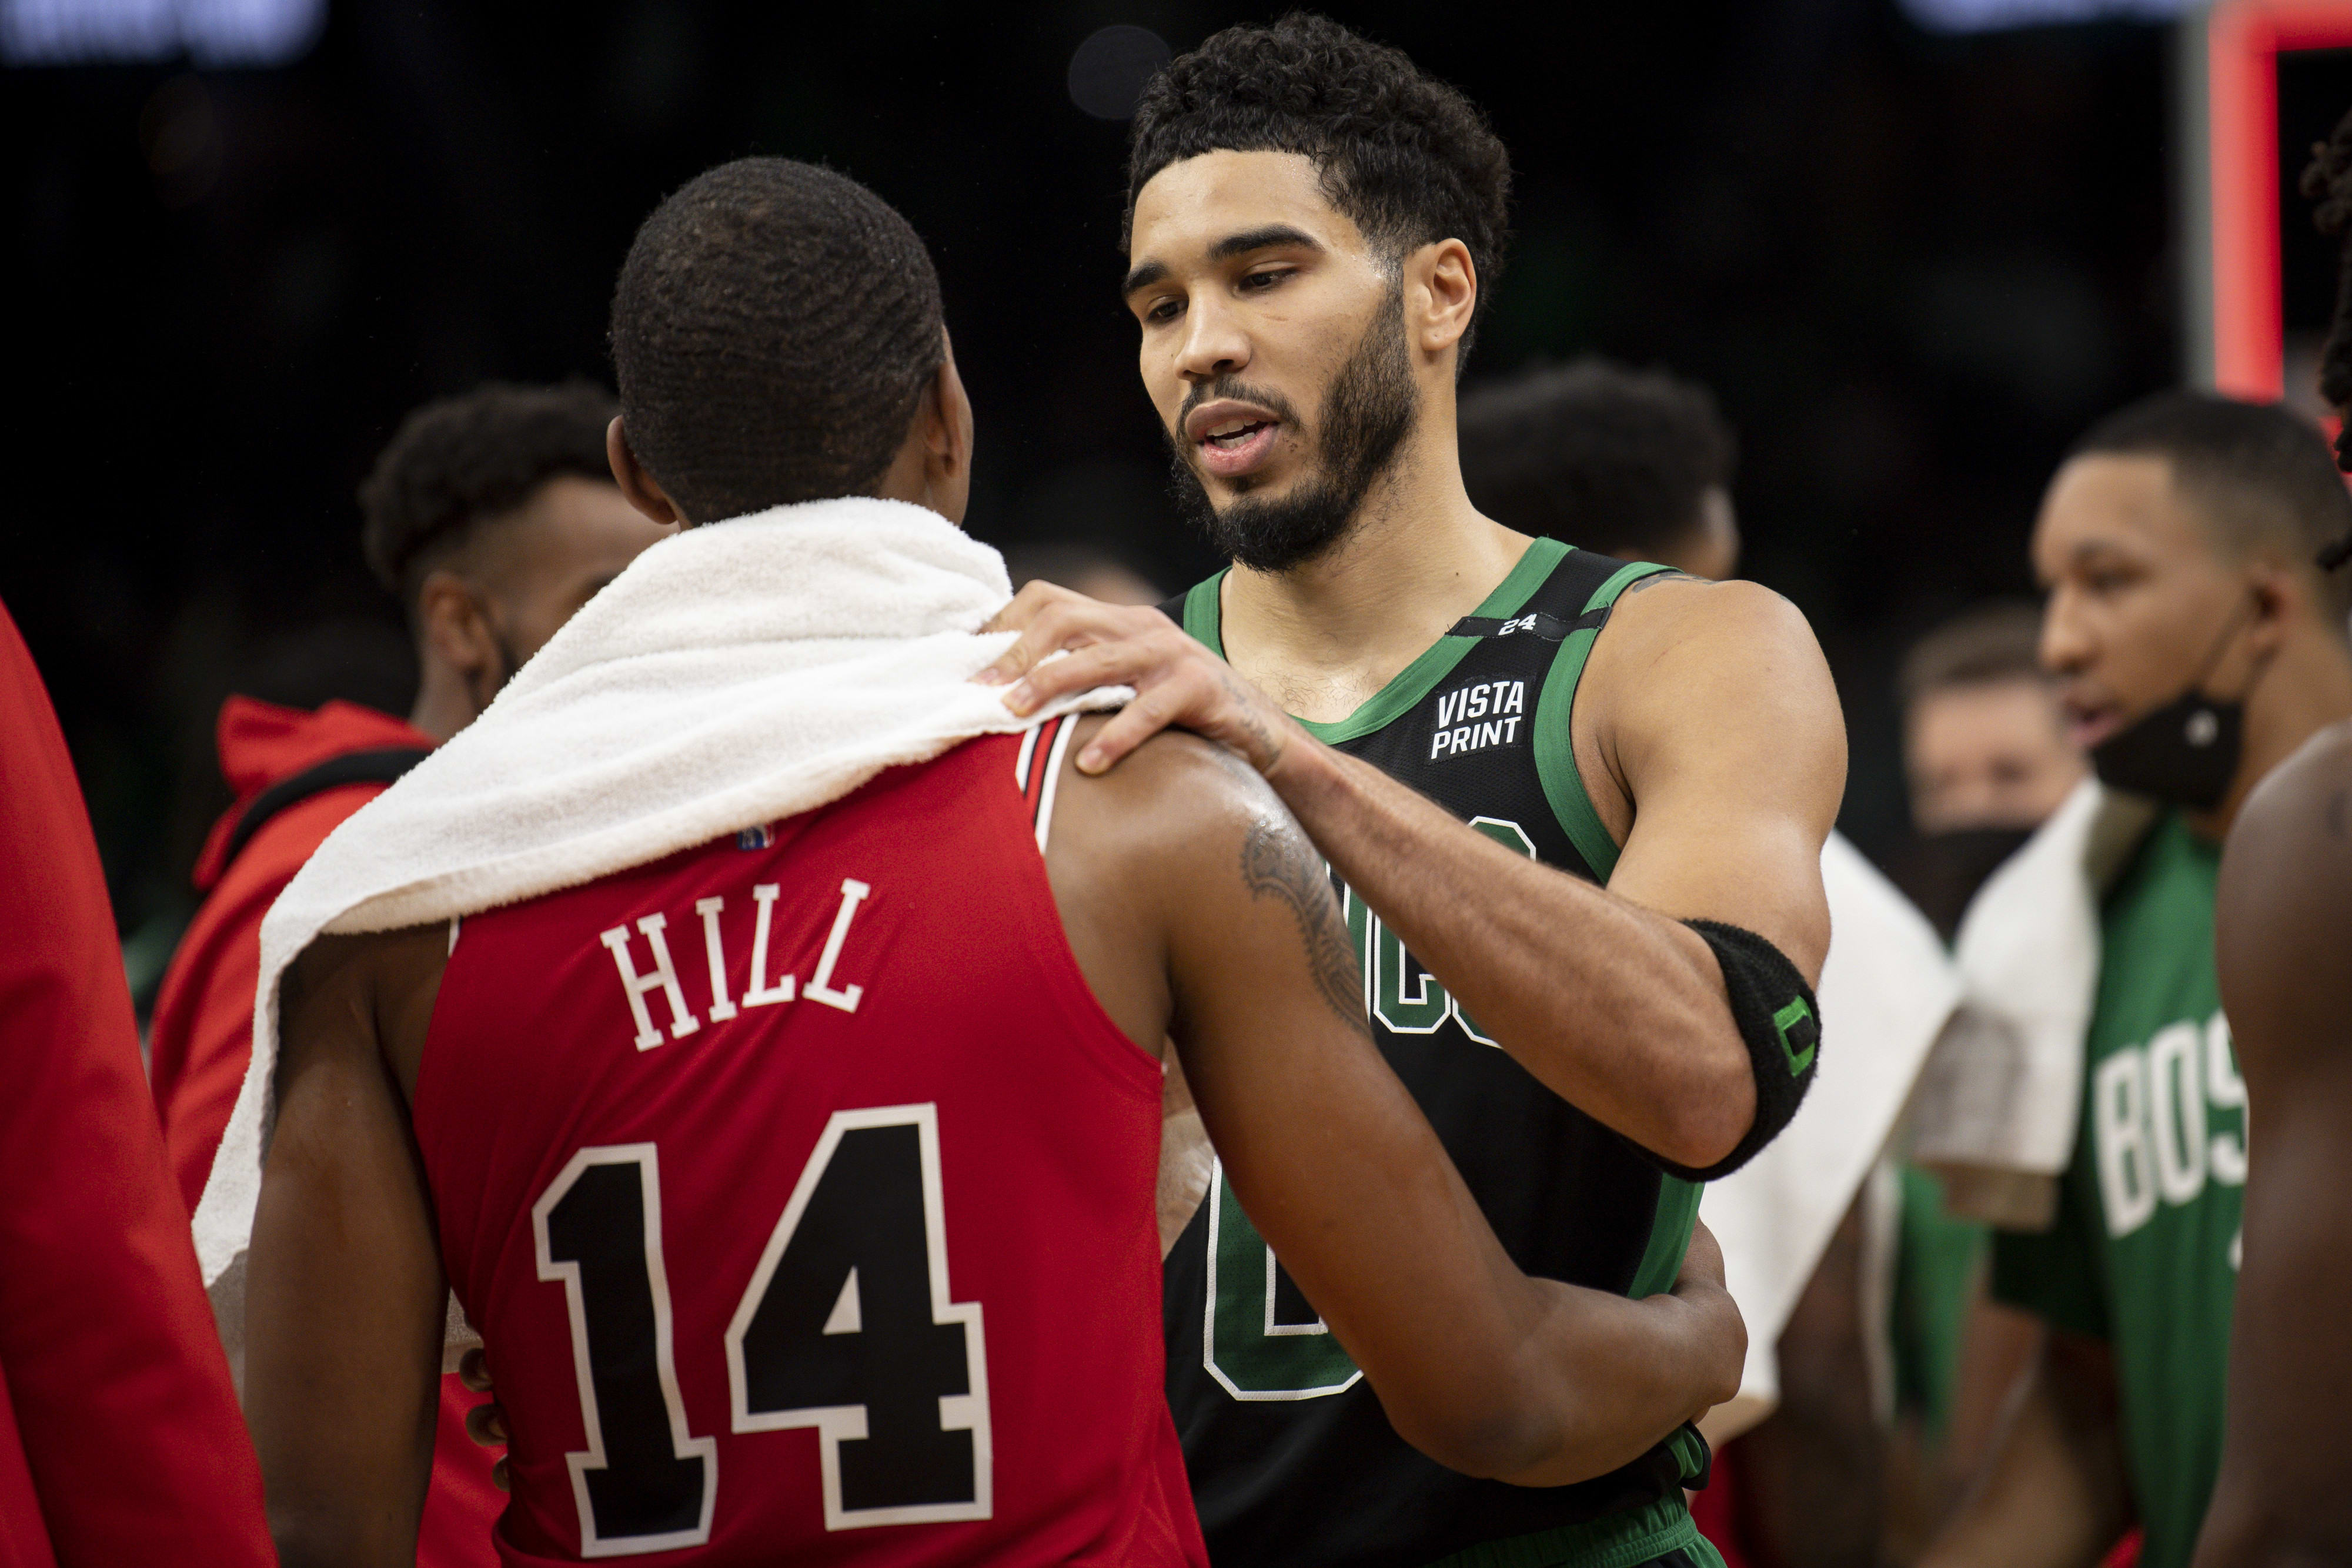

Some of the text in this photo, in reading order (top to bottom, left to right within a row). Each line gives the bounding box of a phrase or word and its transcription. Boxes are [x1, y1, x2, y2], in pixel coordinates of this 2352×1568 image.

[1498, 613, 1538, 636] 24
[1438, 681, 1524, 729] VISTA
[1431, 716, 1522, 760] PRINT
[600, 878, 871, 1052] HILL
[532, 1101, 993, 1559] 14
